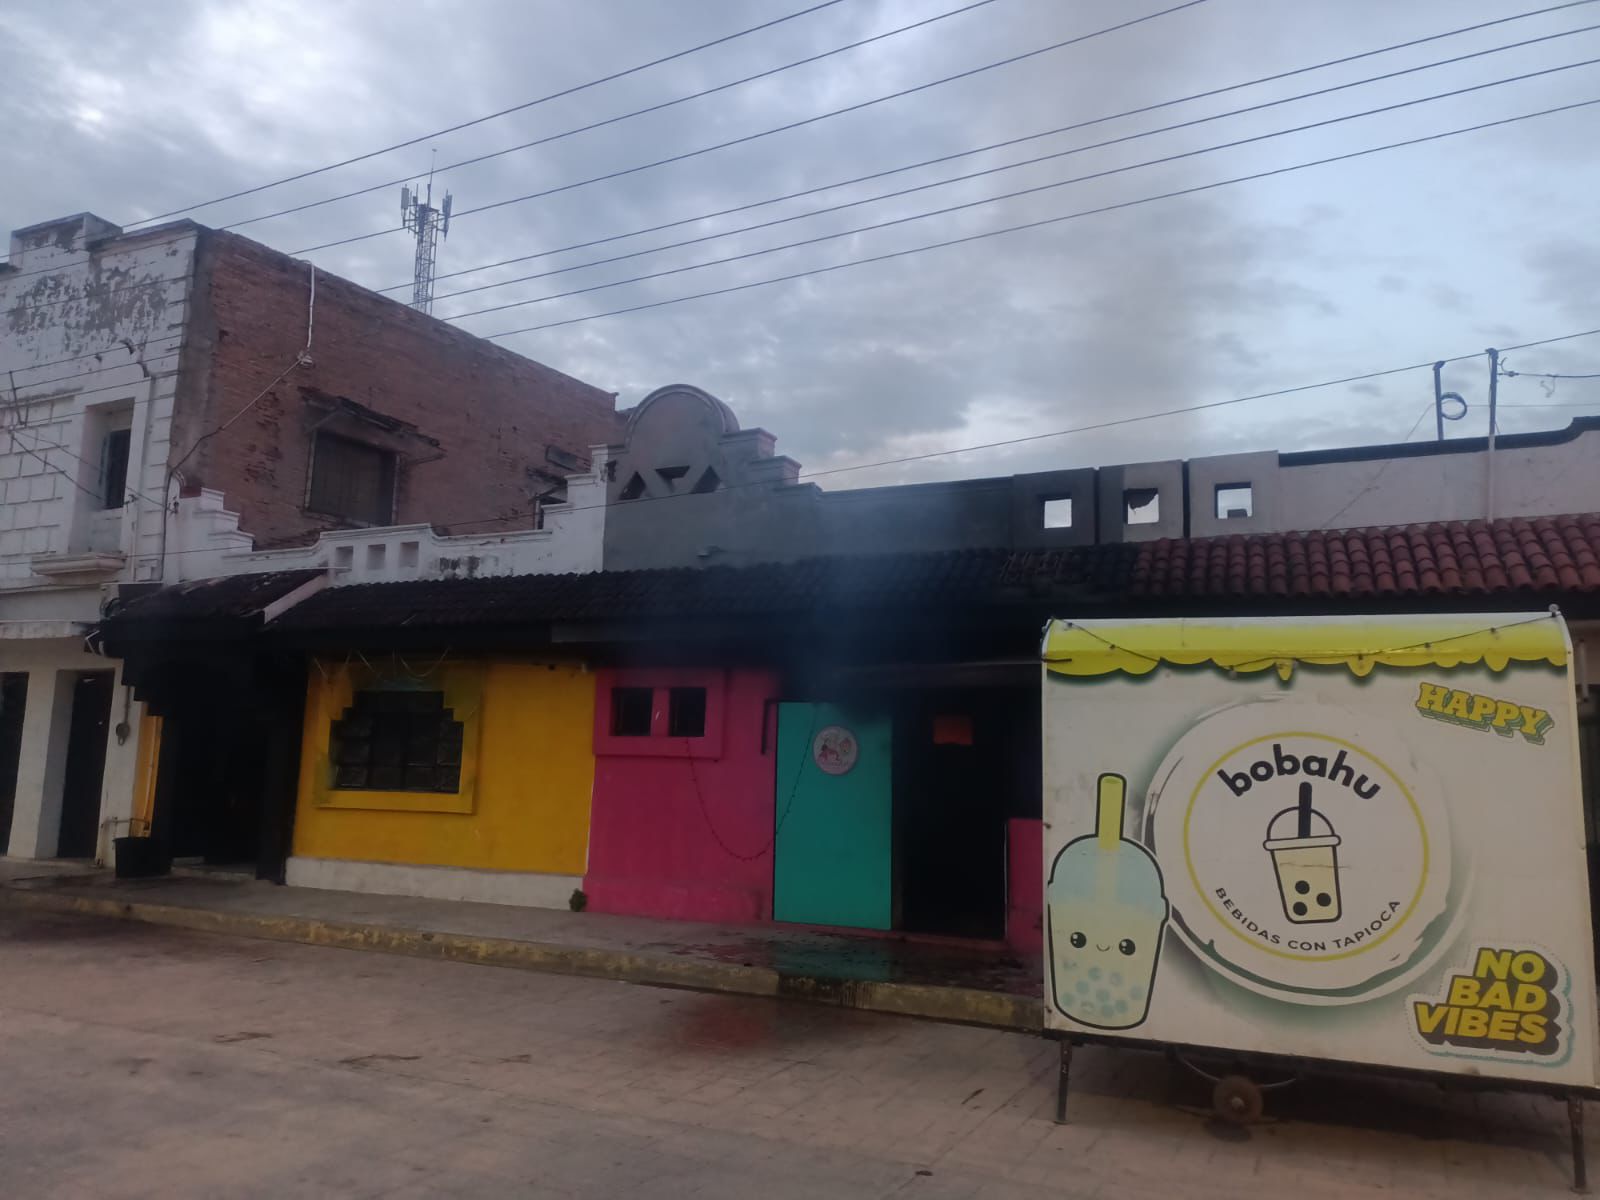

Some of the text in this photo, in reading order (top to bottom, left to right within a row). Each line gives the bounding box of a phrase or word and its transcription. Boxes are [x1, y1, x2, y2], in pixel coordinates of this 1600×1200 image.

[1415, 682, 1552, 743] HAPPY
[1217, 743, 1381, 799] bobahu
[1215, 887, 1401, 952] BEBIDAS CON TAPIOCA
[1474, 949, 1544, 982] NO
[1448, 976, 1547, 1013] BAD
[1413, 1002, 1547, 1045] VIBES
